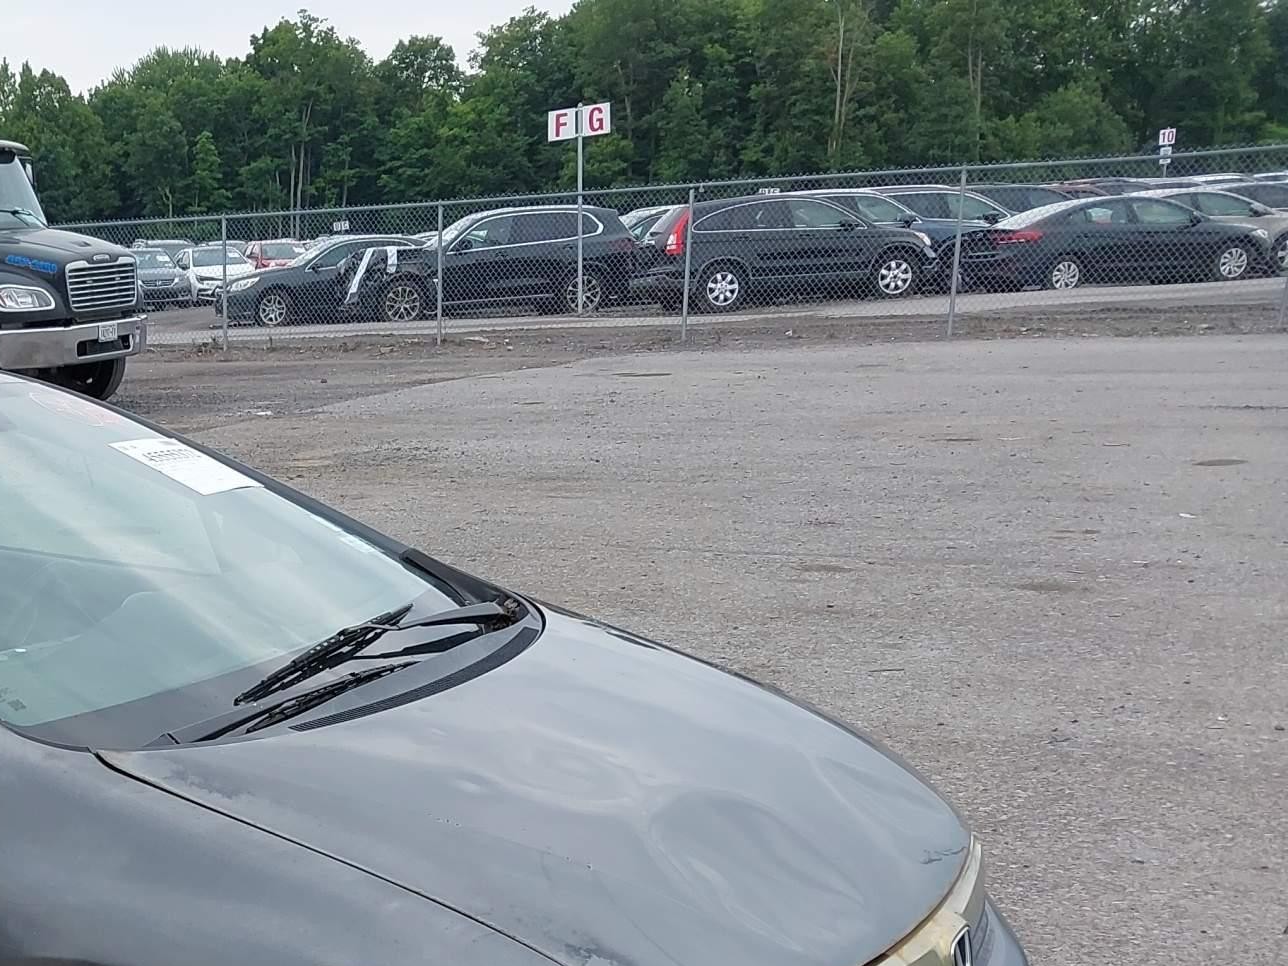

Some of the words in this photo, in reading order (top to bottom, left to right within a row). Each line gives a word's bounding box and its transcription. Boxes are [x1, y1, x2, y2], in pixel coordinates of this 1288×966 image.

[555, 112, 568, 138] F
[588, 106, 604, 132] G
[1161, 130, 1174, 143] 10
